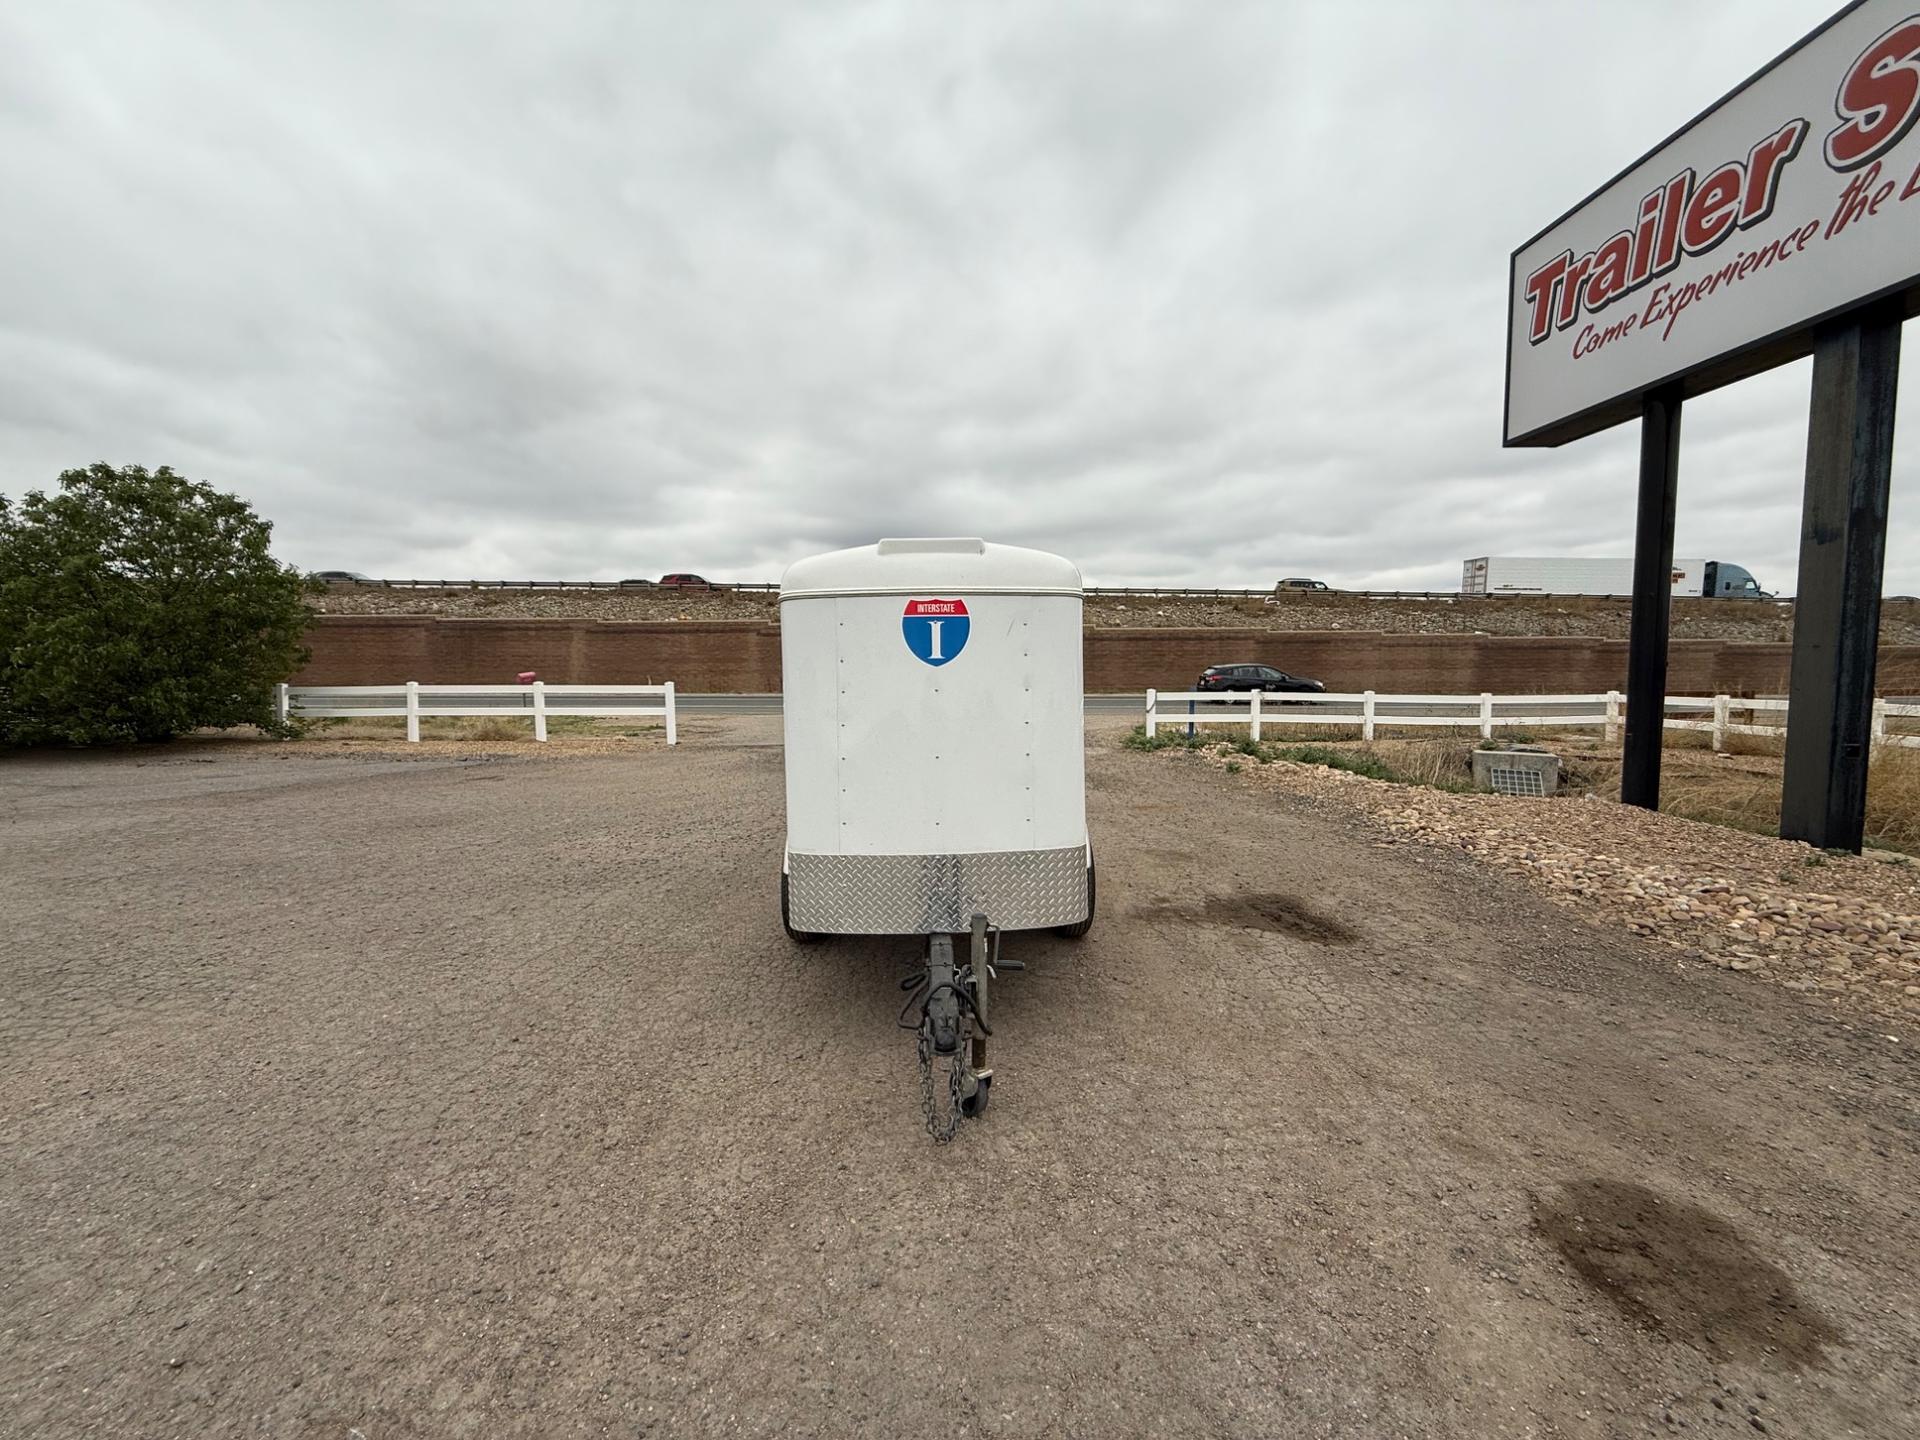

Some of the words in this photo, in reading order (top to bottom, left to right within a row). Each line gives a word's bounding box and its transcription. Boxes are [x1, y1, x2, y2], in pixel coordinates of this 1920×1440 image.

[1524, 117, 1811, 346] Trailer
[1573, 323, 1638, 360] Come
[1639, 219, 1820, 342] Experience
[1824, 160, 1896, 241] the
[916, 603, 956, 613] INTERSTATE
